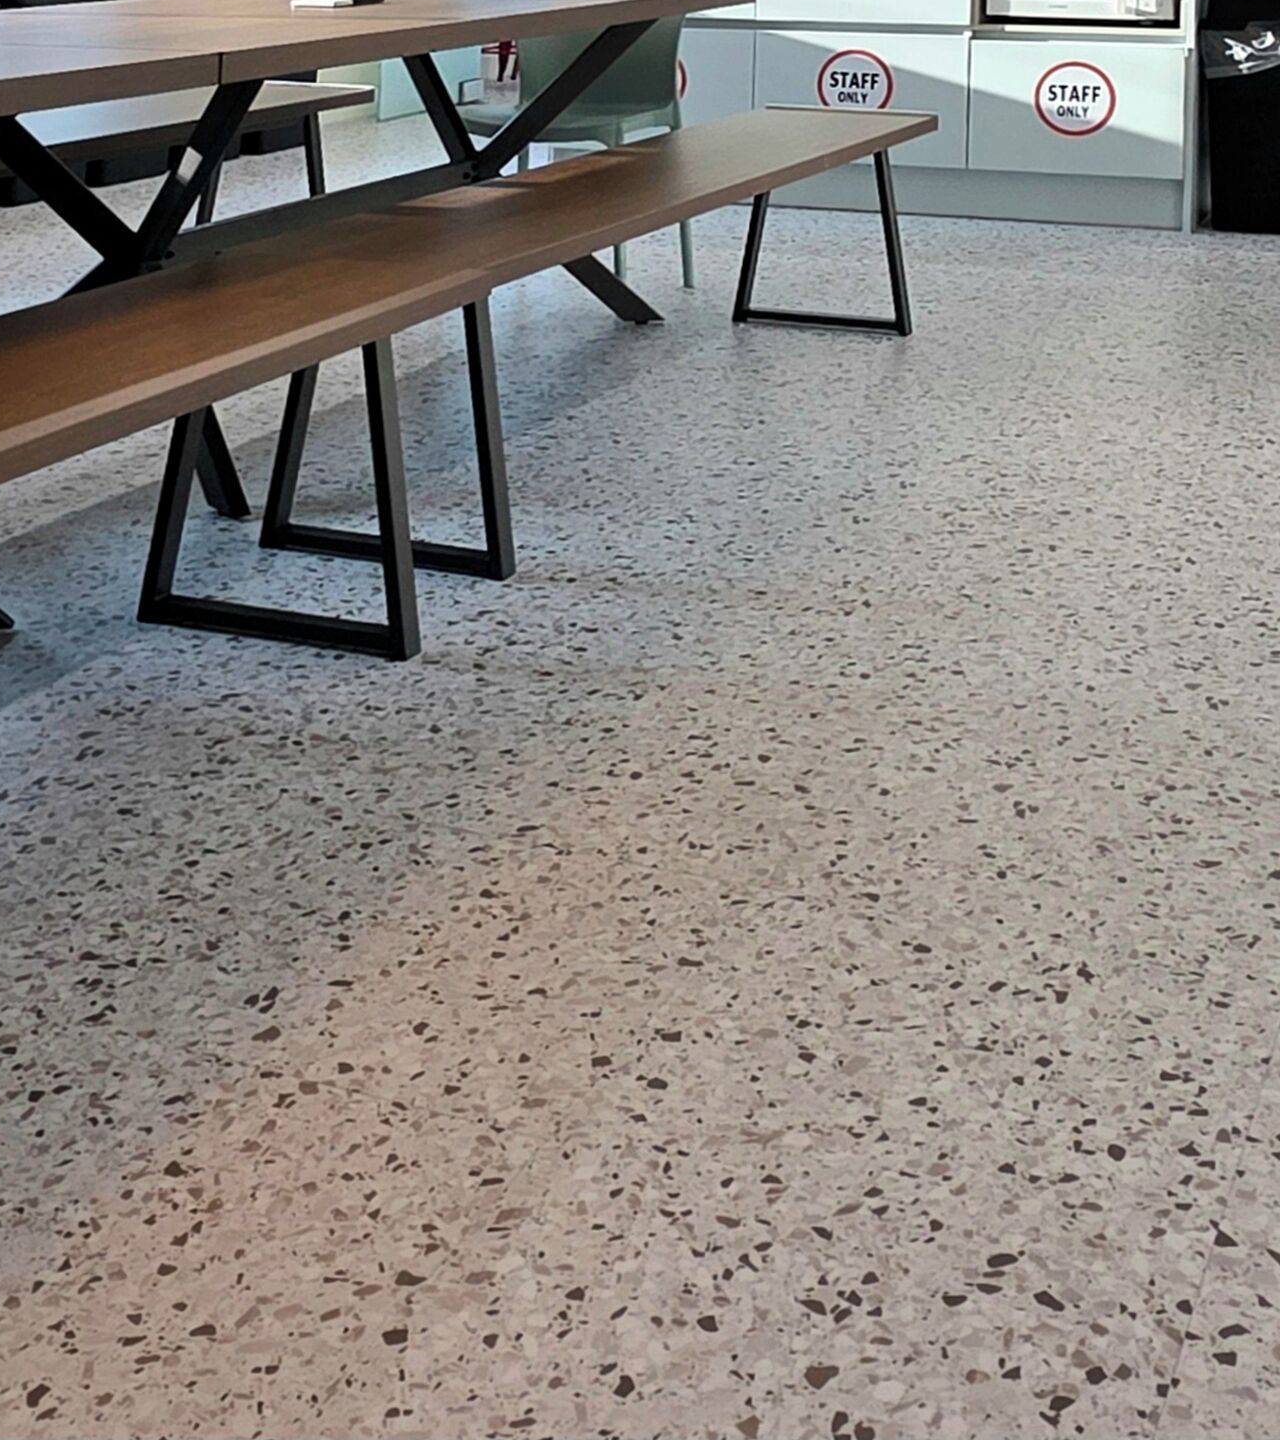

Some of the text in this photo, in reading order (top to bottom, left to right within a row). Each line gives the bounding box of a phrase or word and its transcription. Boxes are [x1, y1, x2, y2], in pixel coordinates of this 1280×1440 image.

[829, 71, 880, 90] STAFF
[838, 91, 868, 104] ONLY
[1048, 84, 1101, 103] STAFF
[1057, 105, 1090, 118] ONLY
